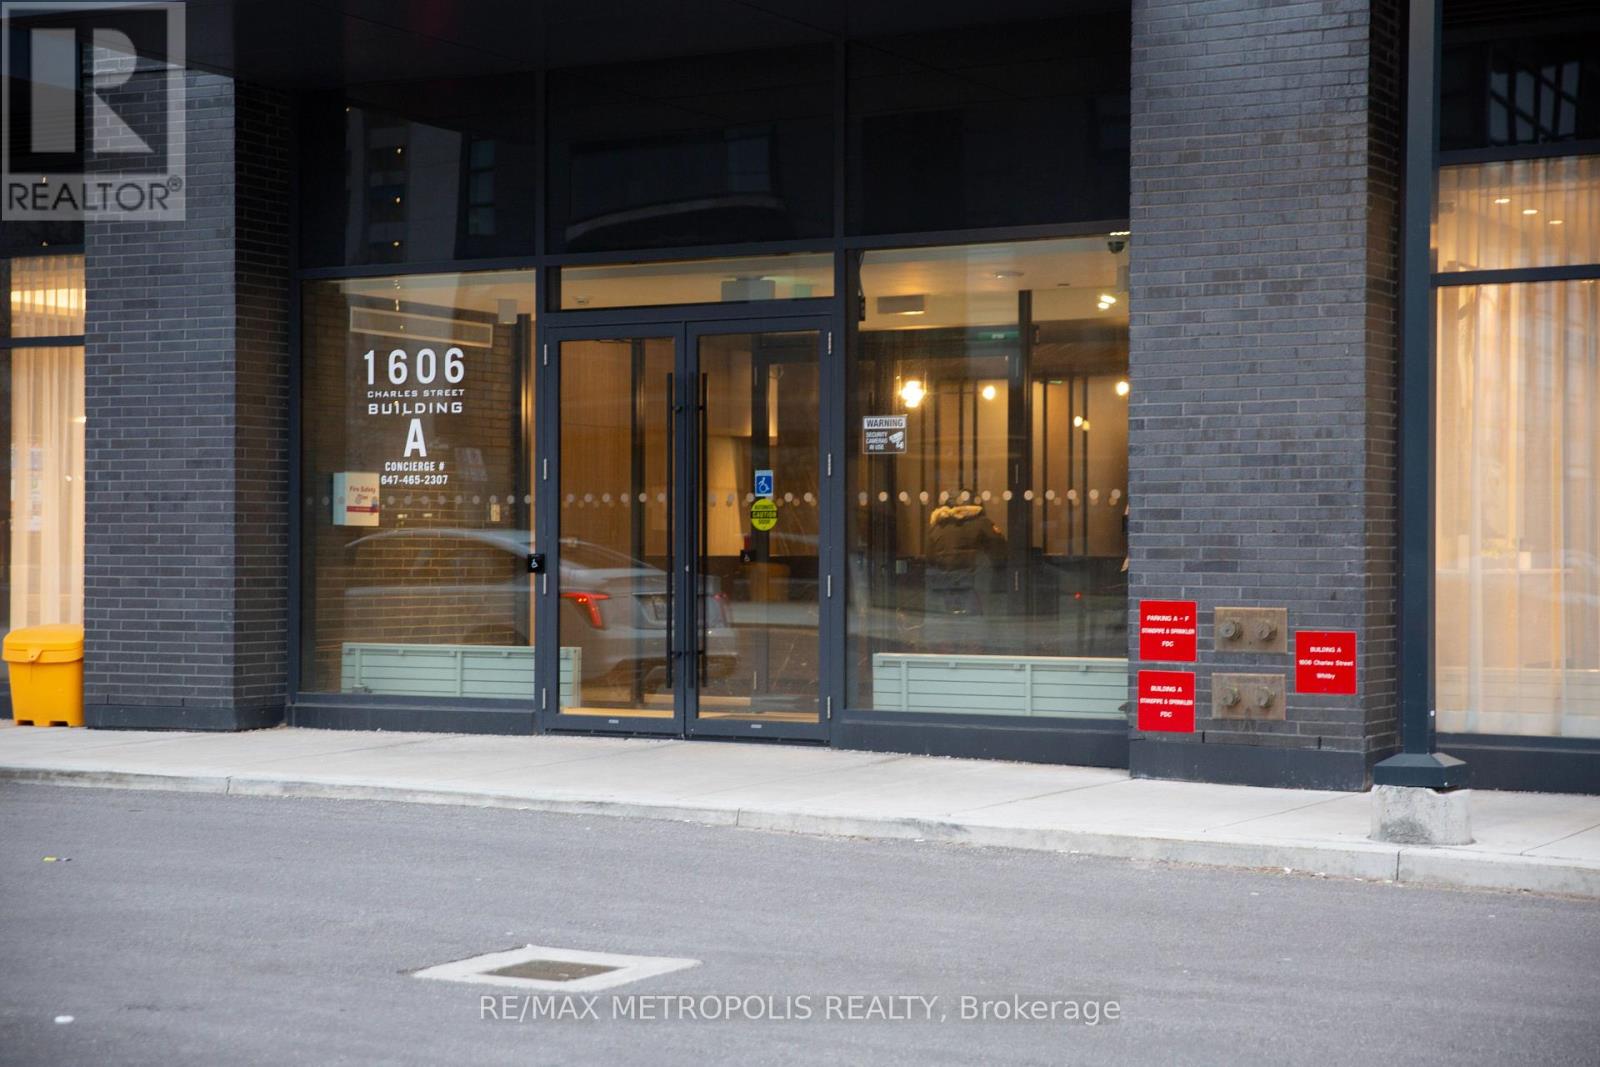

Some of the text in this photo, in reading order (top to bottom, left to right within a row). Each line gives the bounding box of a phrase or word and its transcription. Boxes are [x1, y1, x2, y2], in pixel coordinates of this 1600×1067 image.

[364, 347, 465, 385] 1606
[367, 389, 465, 398] CHARLES STREET
[368, 402, 463, 415] BUILDING
[866, 418, 904, 428] WARNING
[403, 418, 427, 457] A
[384, 461, 445, 472] CONCIERGE #
[380, 475, 449, 485] 647-465-2307
[1316, 672, 1336, 680] Whitby
